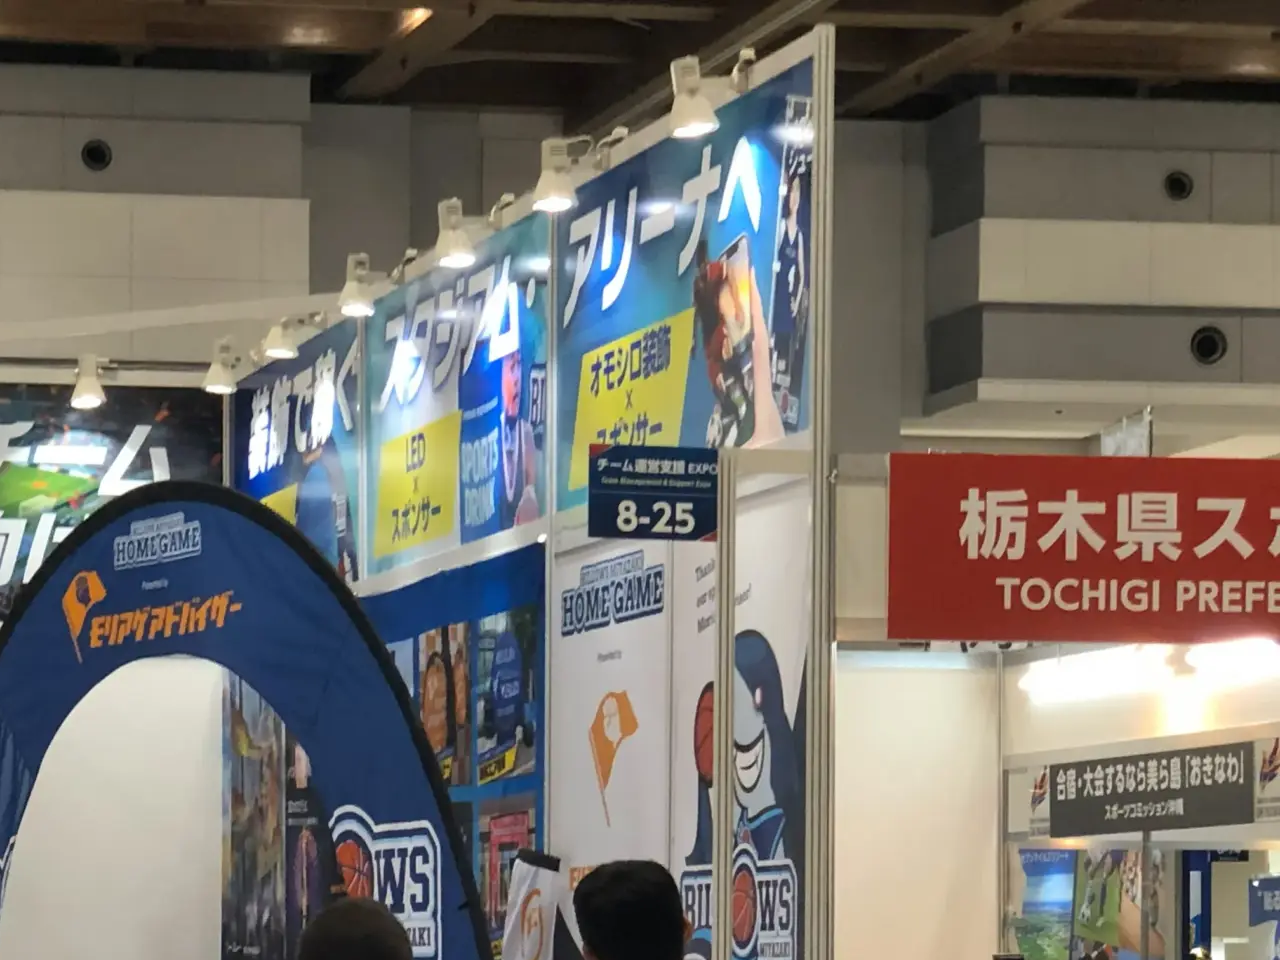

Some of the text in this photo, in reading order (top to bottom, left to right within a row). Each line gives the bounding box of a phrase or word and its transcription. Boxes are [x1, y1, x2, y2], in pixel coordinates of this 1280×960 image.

[563, 136, 762, 329] アリーナへ
[406, 433, 426, 473] LED
[687, 462, 718, 475] EXPO
[616, 500, 696, 534] 8-25
[959, 487, 1280, 563] 栃木県ス
[116, 536, 157, 563] HOME
[160, 526, 200, 555] GAME
[563, 586, 611, 628] HOME
[613, 570, 663, 615] GAME
[996, 577, 1160, 611] TOCHIGI
